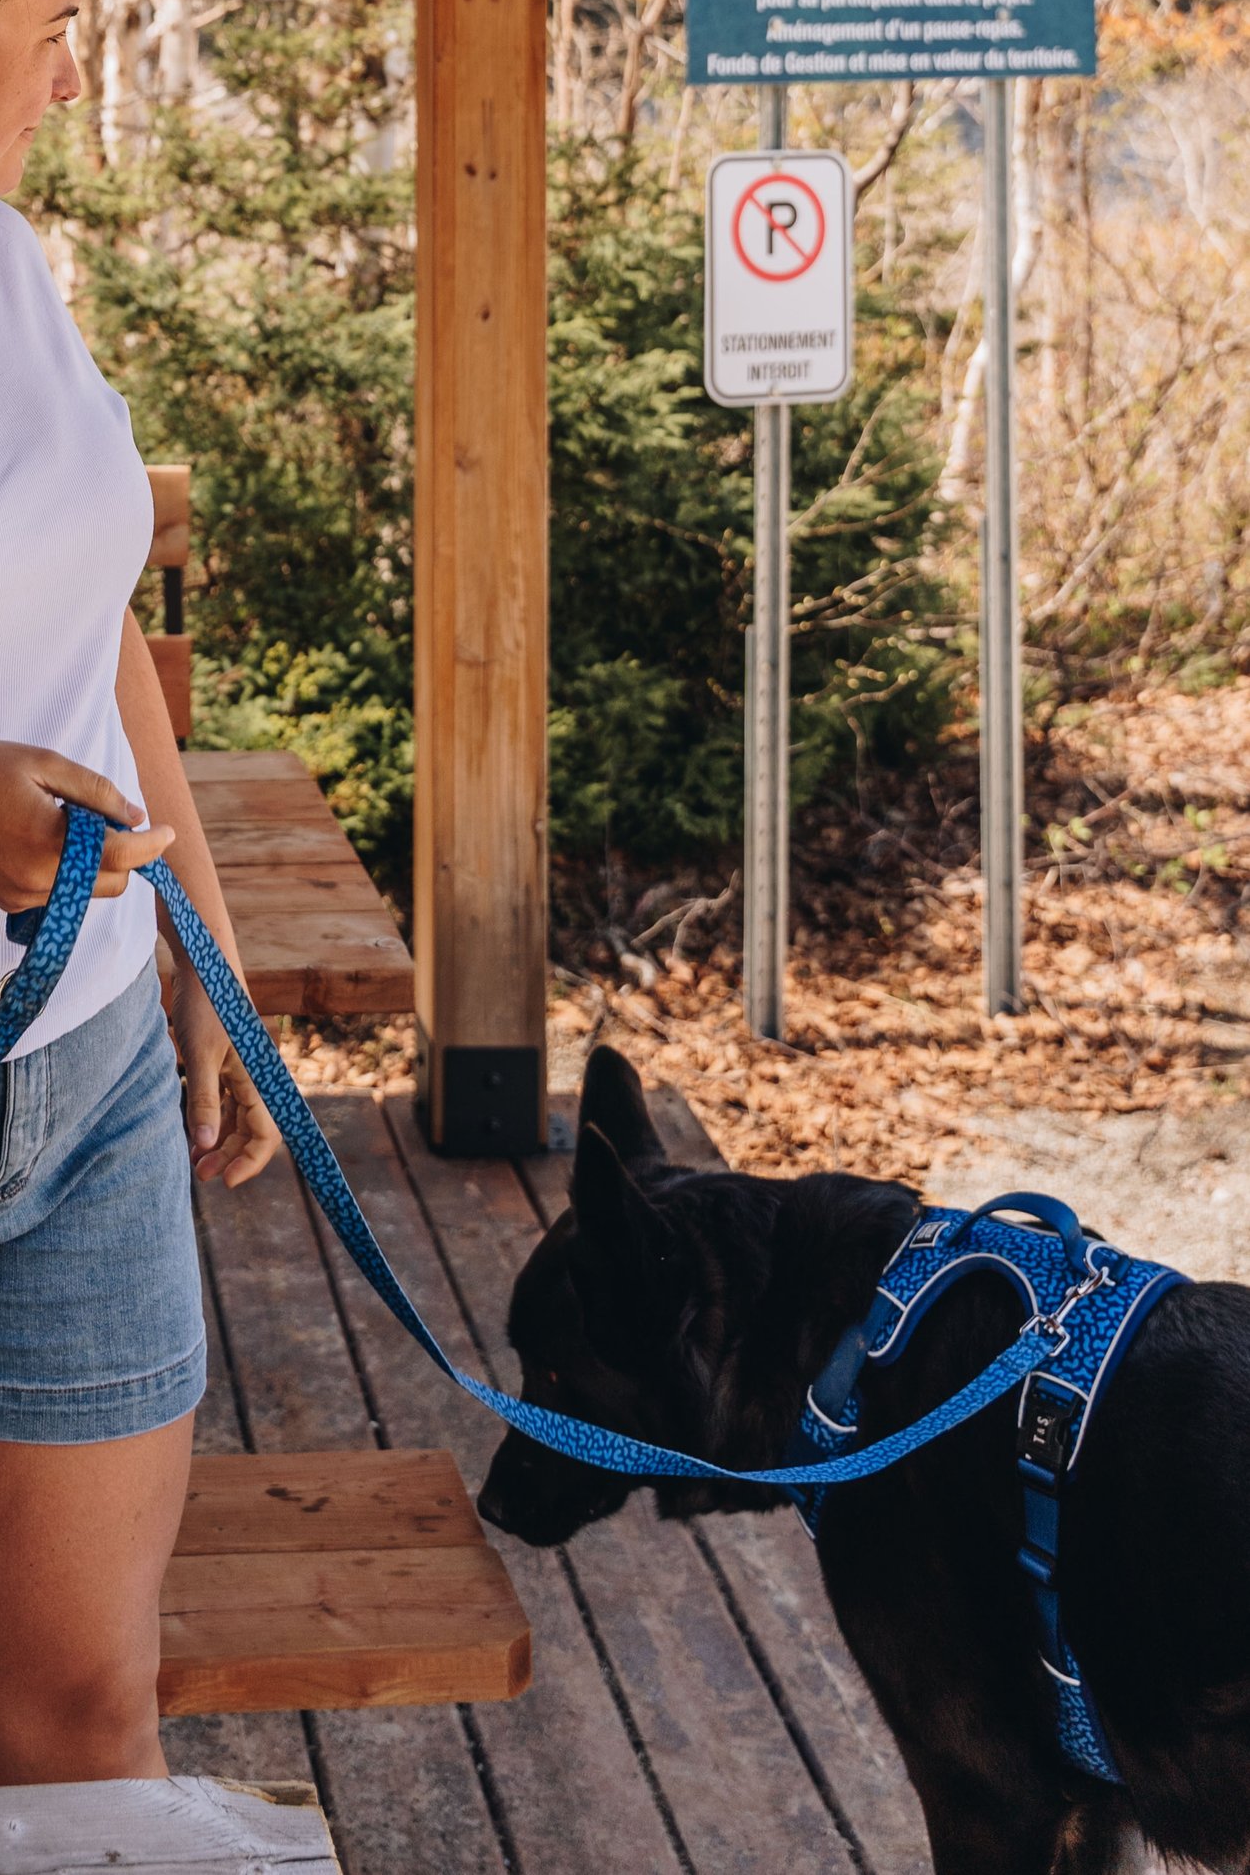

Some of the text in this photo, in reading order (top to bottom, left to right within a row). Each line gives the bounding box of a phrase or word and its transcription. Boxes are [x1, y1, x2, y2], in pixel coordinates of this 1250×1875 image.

[885, 20, 921, 40] d'un
[707, 53, 756, 75] Fonds
[760, 53, 781, 73] de
[785, 51, 846, 74] Gestion
[849, 51, 865, 73] et
[868, 51, 907, 72] mise
[910, 52, 930, 71] en
[933, 51, 982, 71] valeur
[984, 50, 1005, 71] du
[767, 202, 796, 254] P
[720, 330, 835, 354] STATIONNEMENT
[747, 360, 810, 381] INTERDIT
